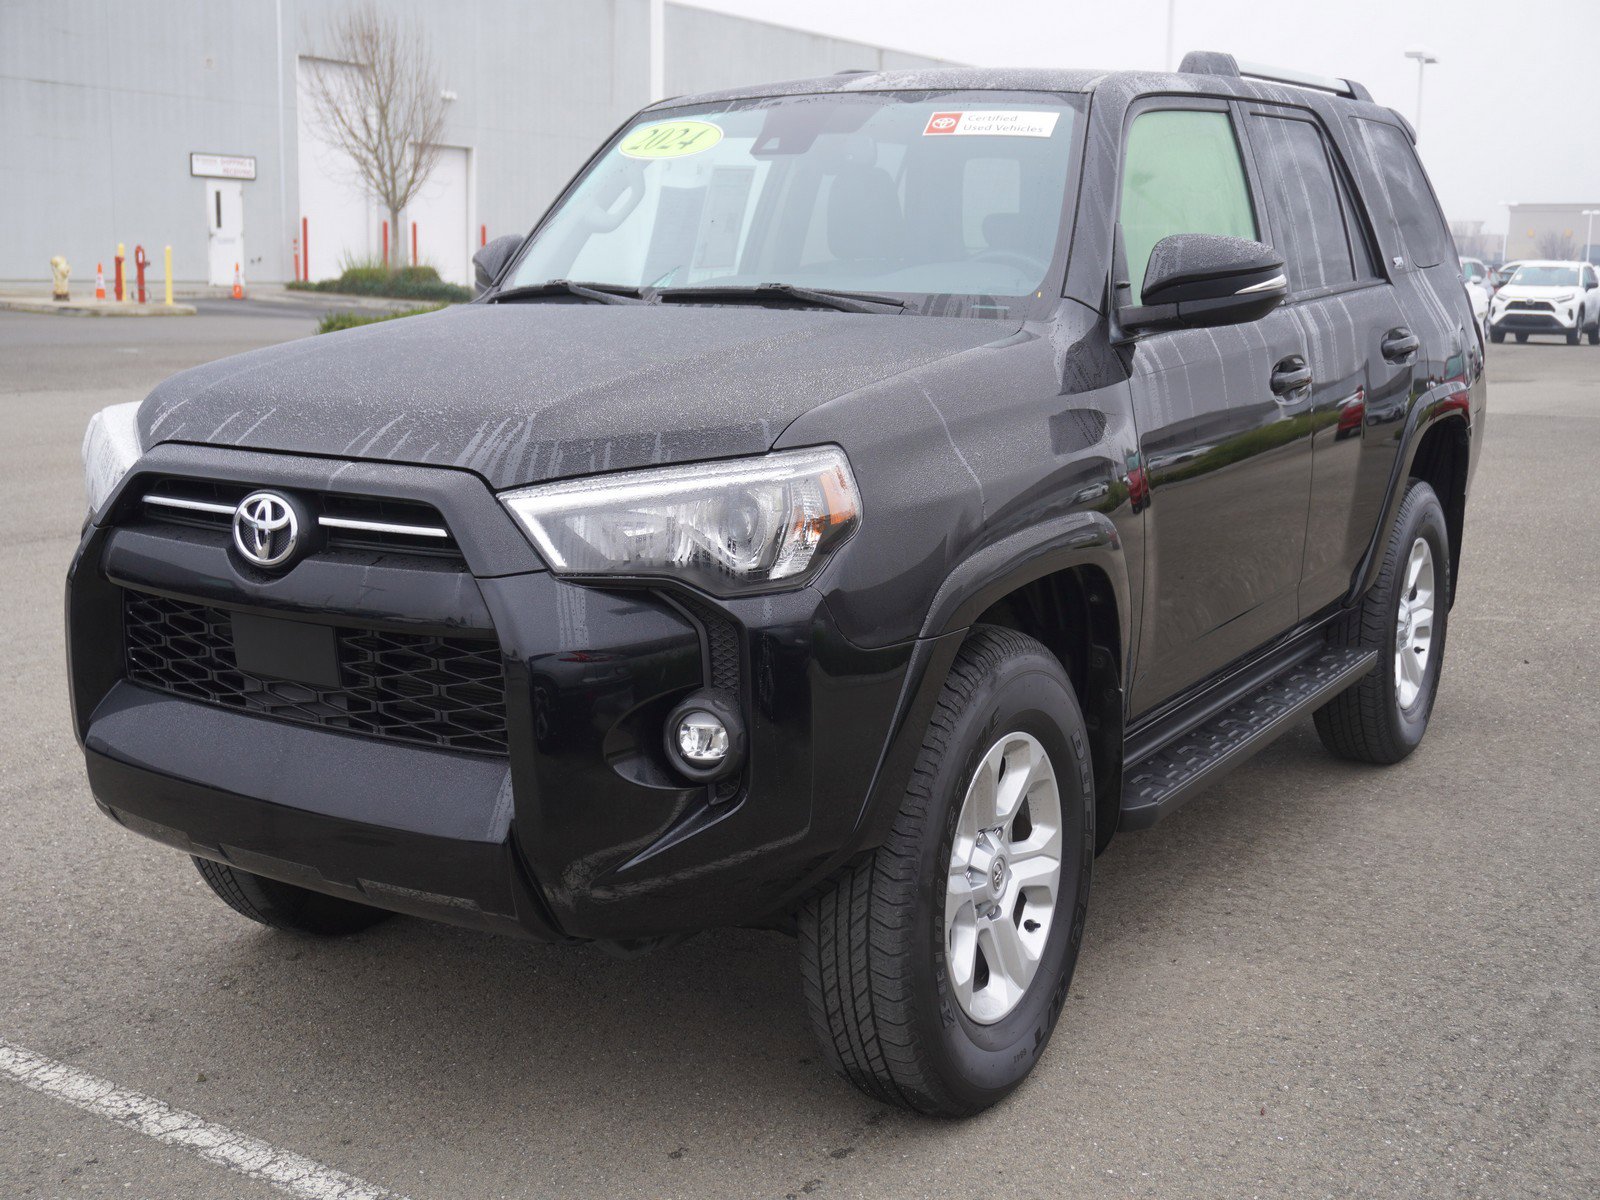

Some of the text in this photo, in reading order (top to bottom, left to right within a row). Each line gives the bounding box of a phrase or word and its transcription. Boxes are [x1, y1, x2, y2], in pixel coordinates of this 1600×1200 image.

[967, 114, 1018, 122] Certified
[996, 124, 1044, 132] Vehicles
[626, 128, 710, 150] 2024
